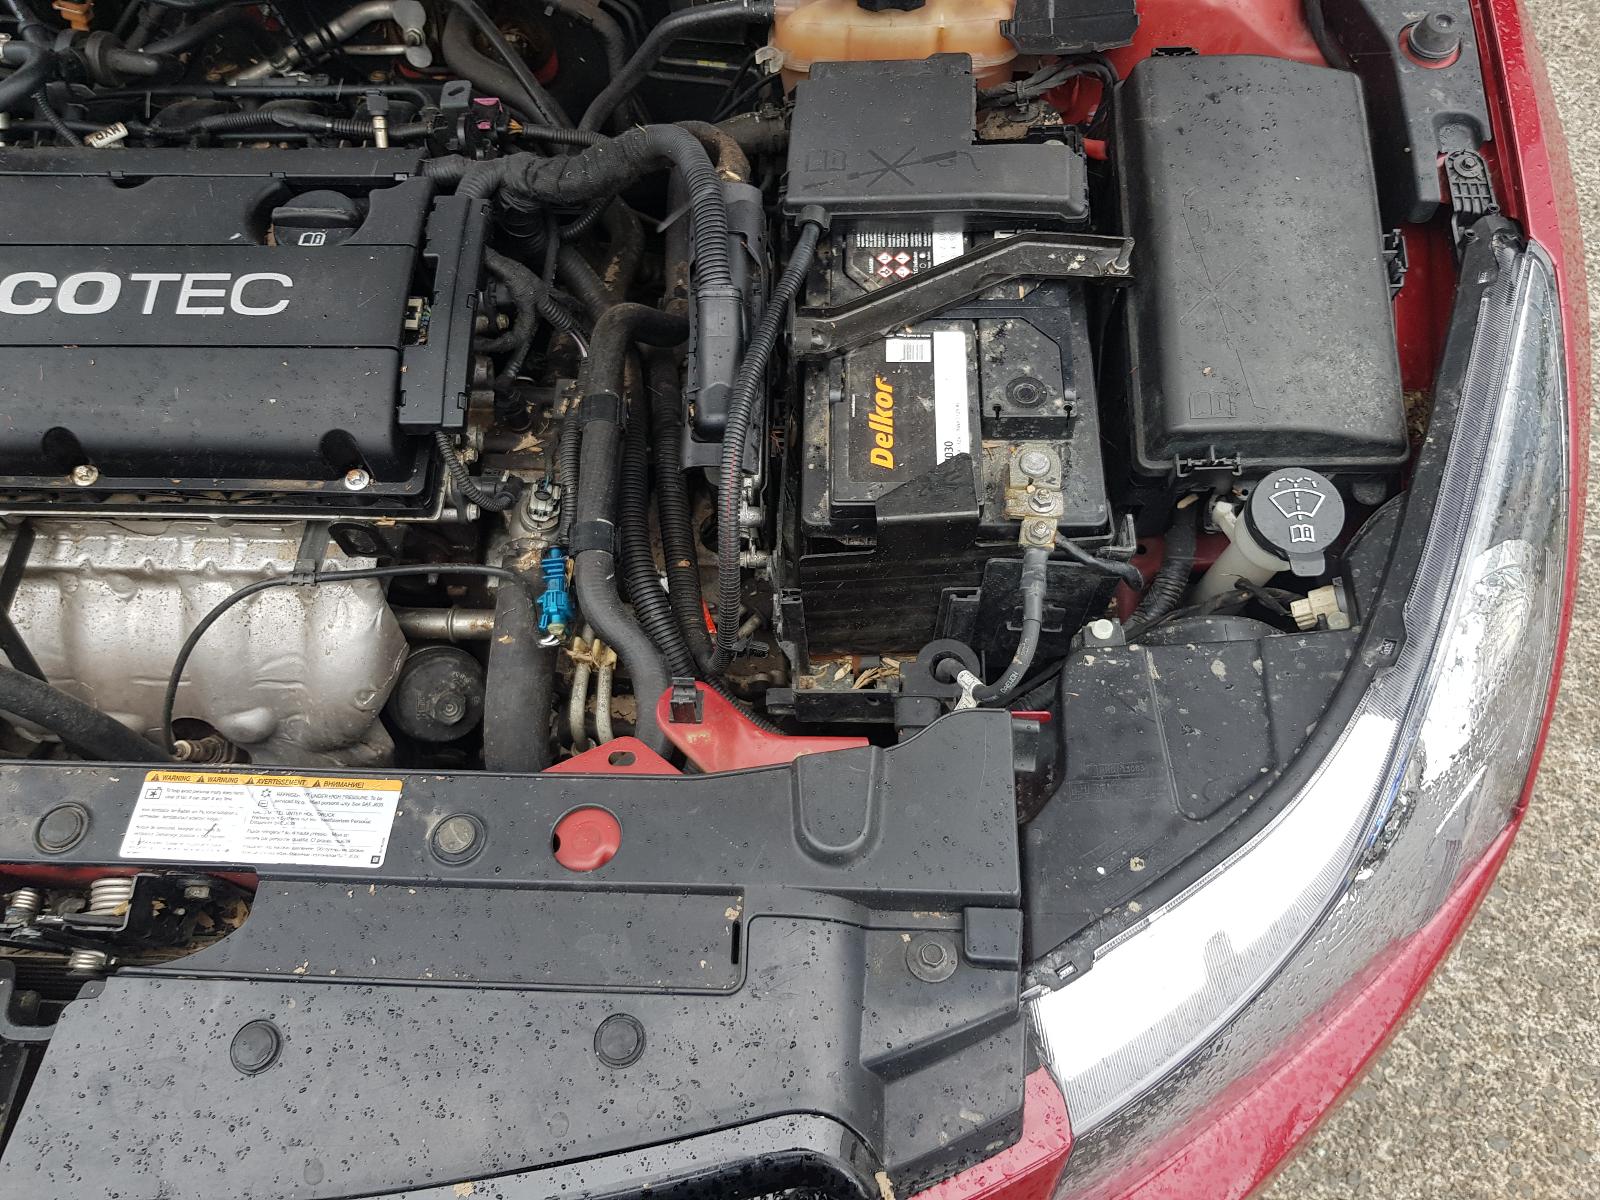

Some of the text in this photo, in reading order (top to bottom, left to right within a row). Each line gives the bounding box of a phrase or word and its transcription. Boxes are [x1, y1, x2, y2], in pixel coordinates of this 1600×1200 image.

[868, 375, 894, 470] Delkor
[944, 440, 953, 461] 030
[162, 774, 191, 782] WARNING
[207, 776, 239, 784] WARNUNG
[256, 778, 306, 786] AVERTISSEMENT
